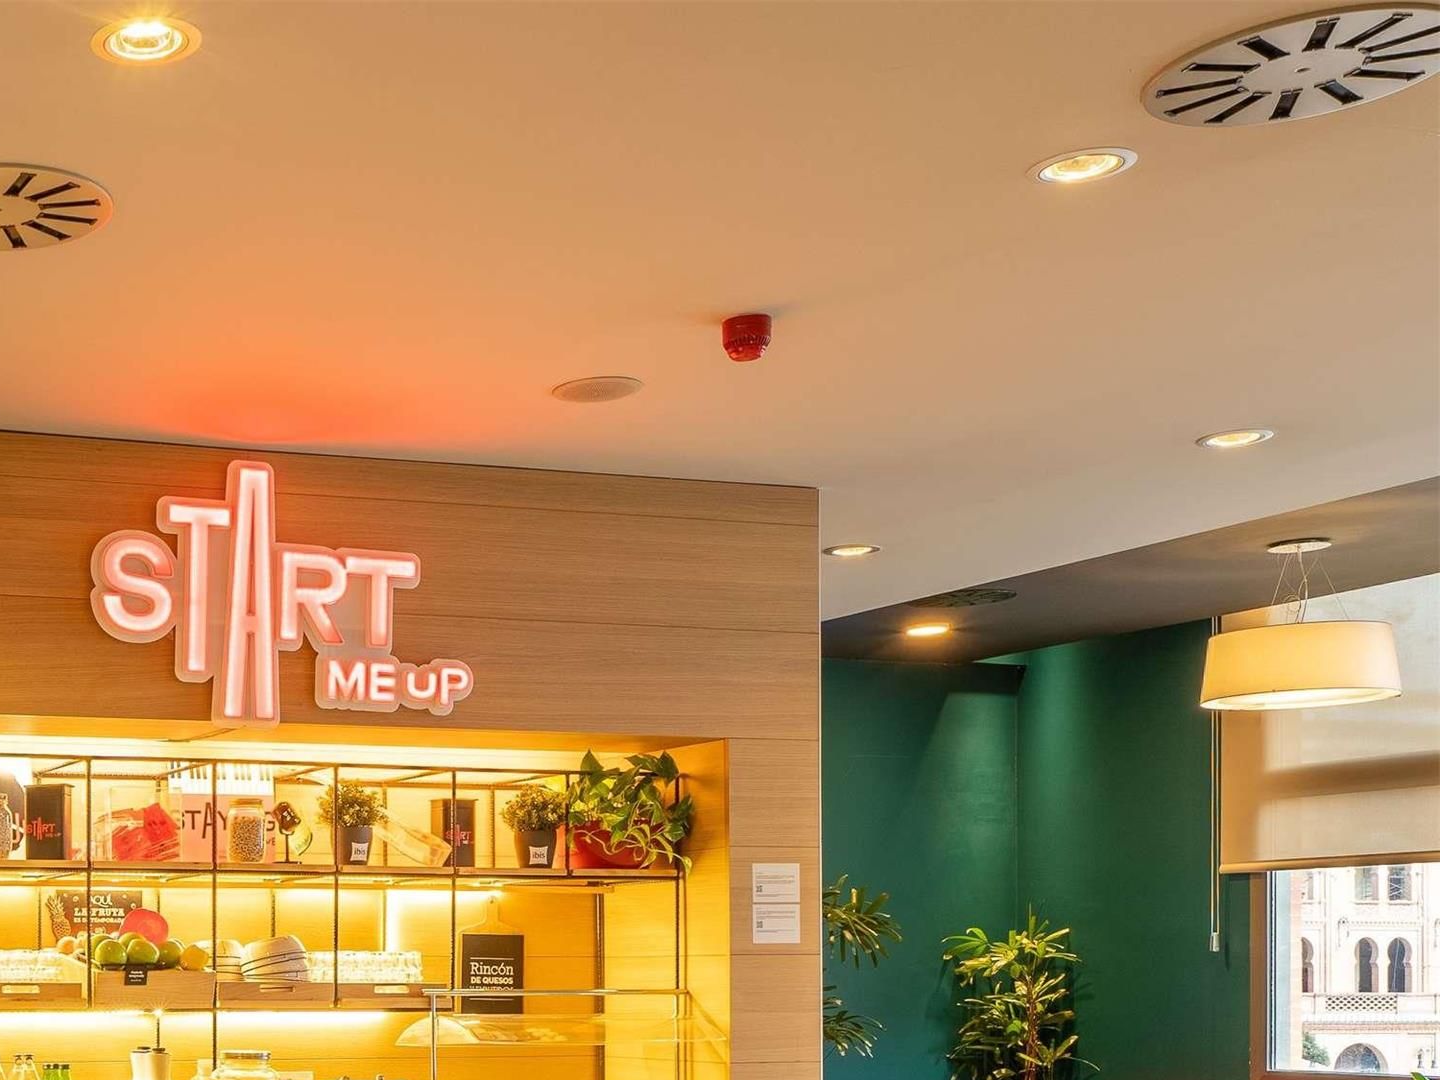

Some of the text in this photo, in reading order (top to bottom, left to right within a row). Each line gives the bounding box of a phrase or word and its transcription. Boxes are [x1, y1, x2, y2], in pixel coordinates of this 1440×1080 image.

[101, 465, 418, 721] START
[327, 659, 470, 705] ME UP
[469, 961, 514, 976] Rincón
[470, 976, 514, 985] DE QUESOS
